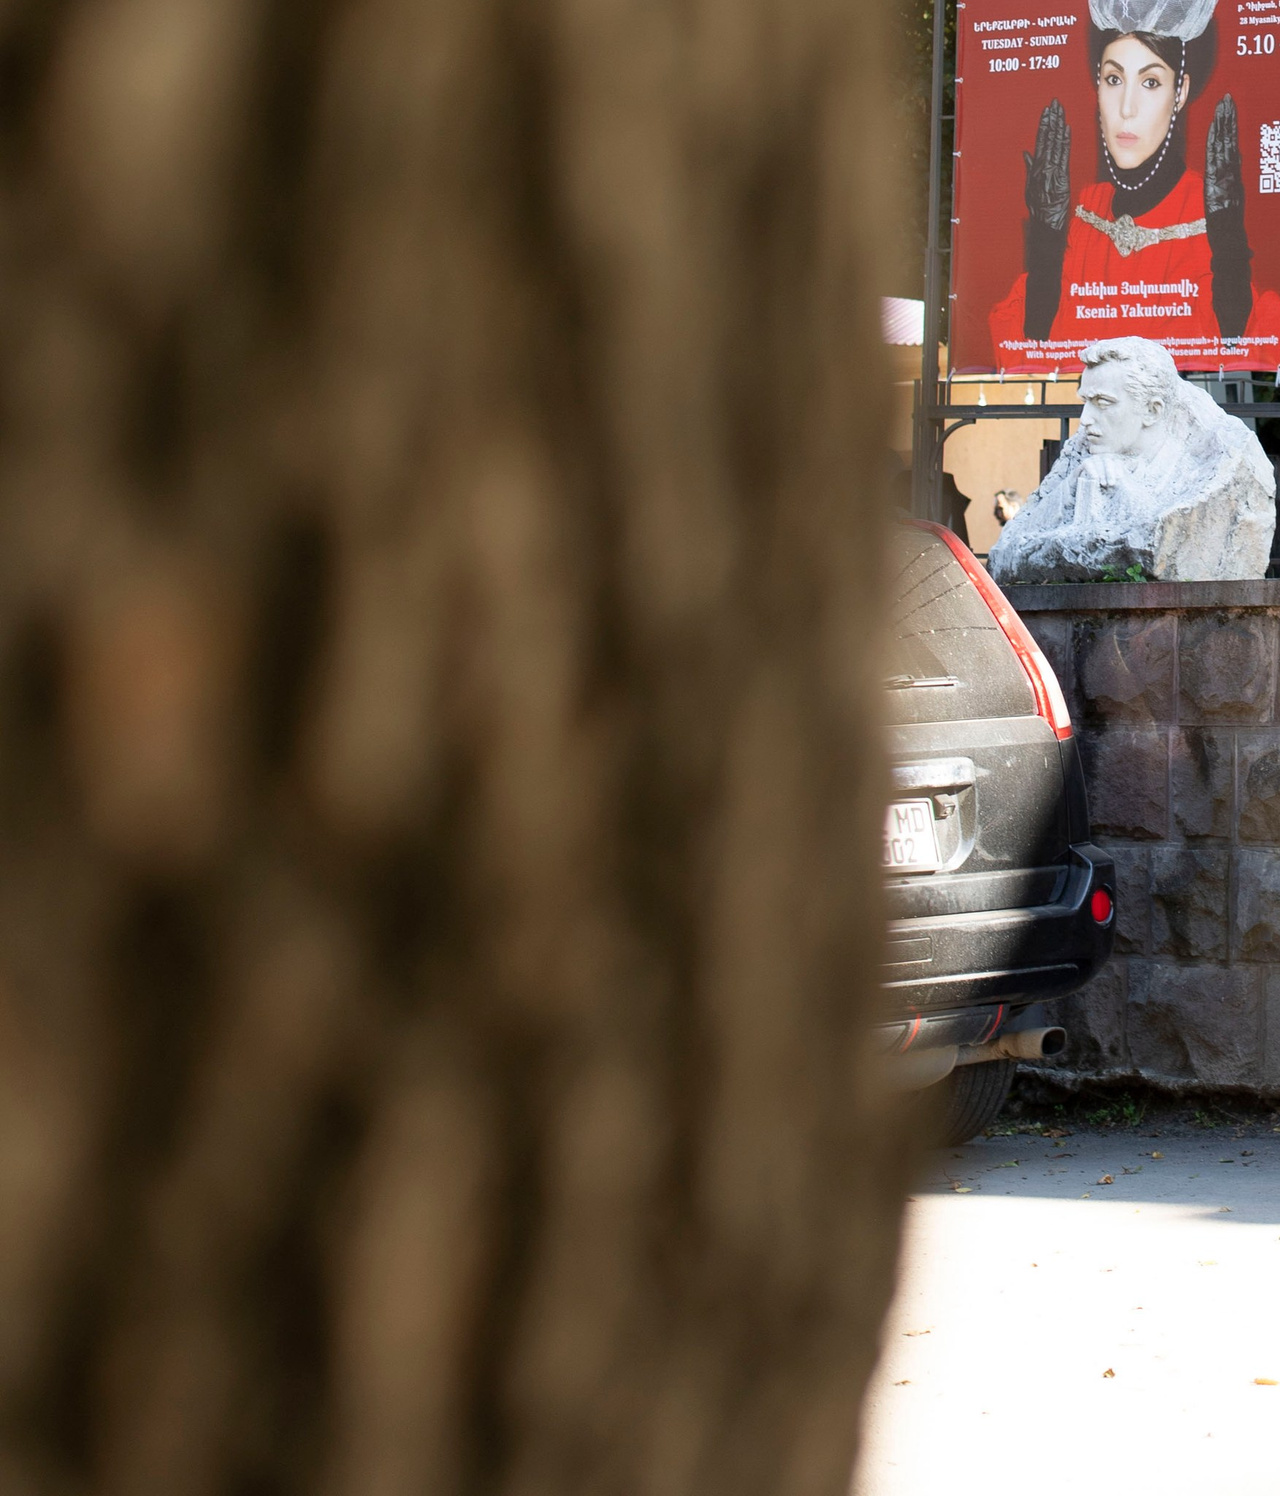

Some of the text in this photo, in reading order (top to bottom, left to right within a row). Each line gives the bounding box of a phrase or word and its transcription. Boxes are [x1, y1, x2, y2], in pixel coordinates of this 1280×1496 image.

[982, 37, 1024, 50] TUESDAY
[1030, 34, 1068, 47] SUNDAY
[1237, 33, 1275, 56] 5.10
[988, 57, 1020, 73] 10:00
[1029, 55, 1060, 70] 17:40
[1075, 302, 1192, 319] Ksenia Yakutovich
[1026, 350, 1044, 359] With
[1045, 350, 1076, 360] support
[1202, 346, 1218, 356] and
[1220, 346, 1250, 357] Gallery
[894, 807, 925, 833] MD
